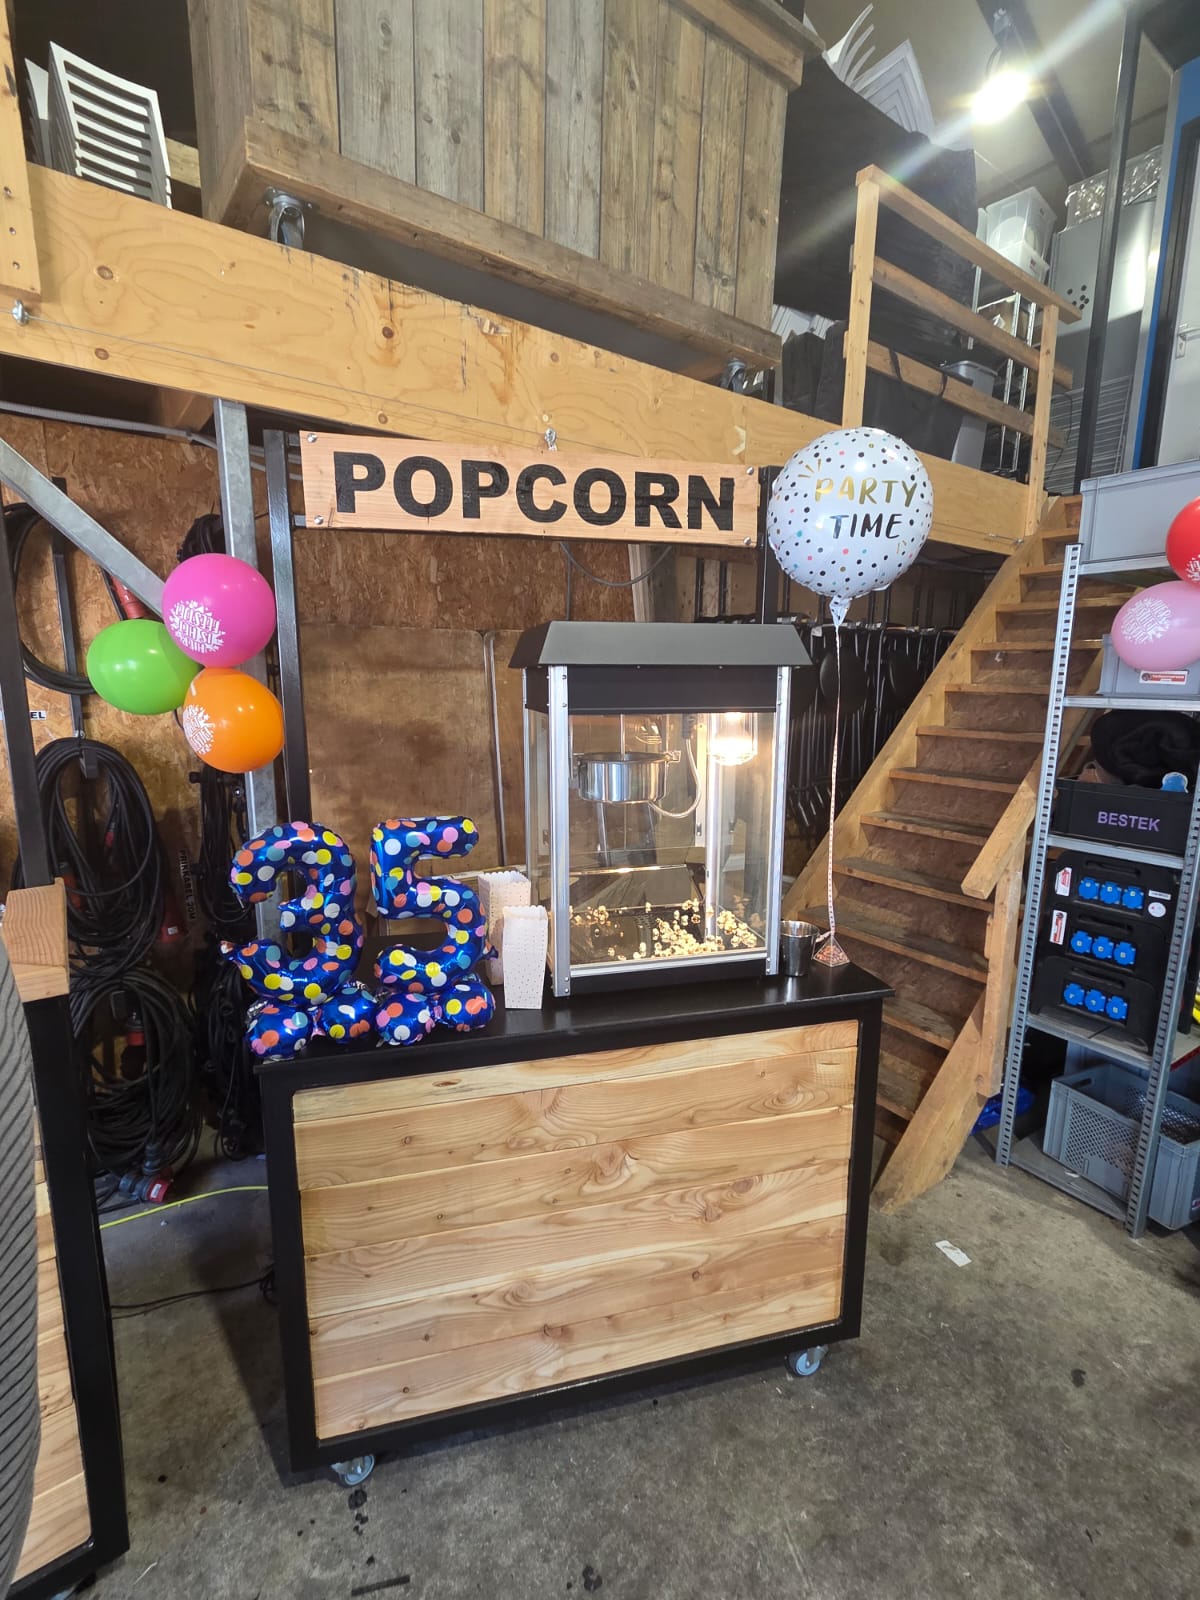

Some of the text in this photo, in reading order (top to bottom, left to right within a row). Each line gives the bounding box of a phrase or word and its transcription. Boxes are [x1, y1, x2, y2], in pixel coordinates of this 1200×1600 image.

[334, 451, 734, 531] POPCORN
[815, 475, 917, 507] PARTY
[829, 513, 903, 539] TIME
[1097, 811, 1161, 832] BESTEK
